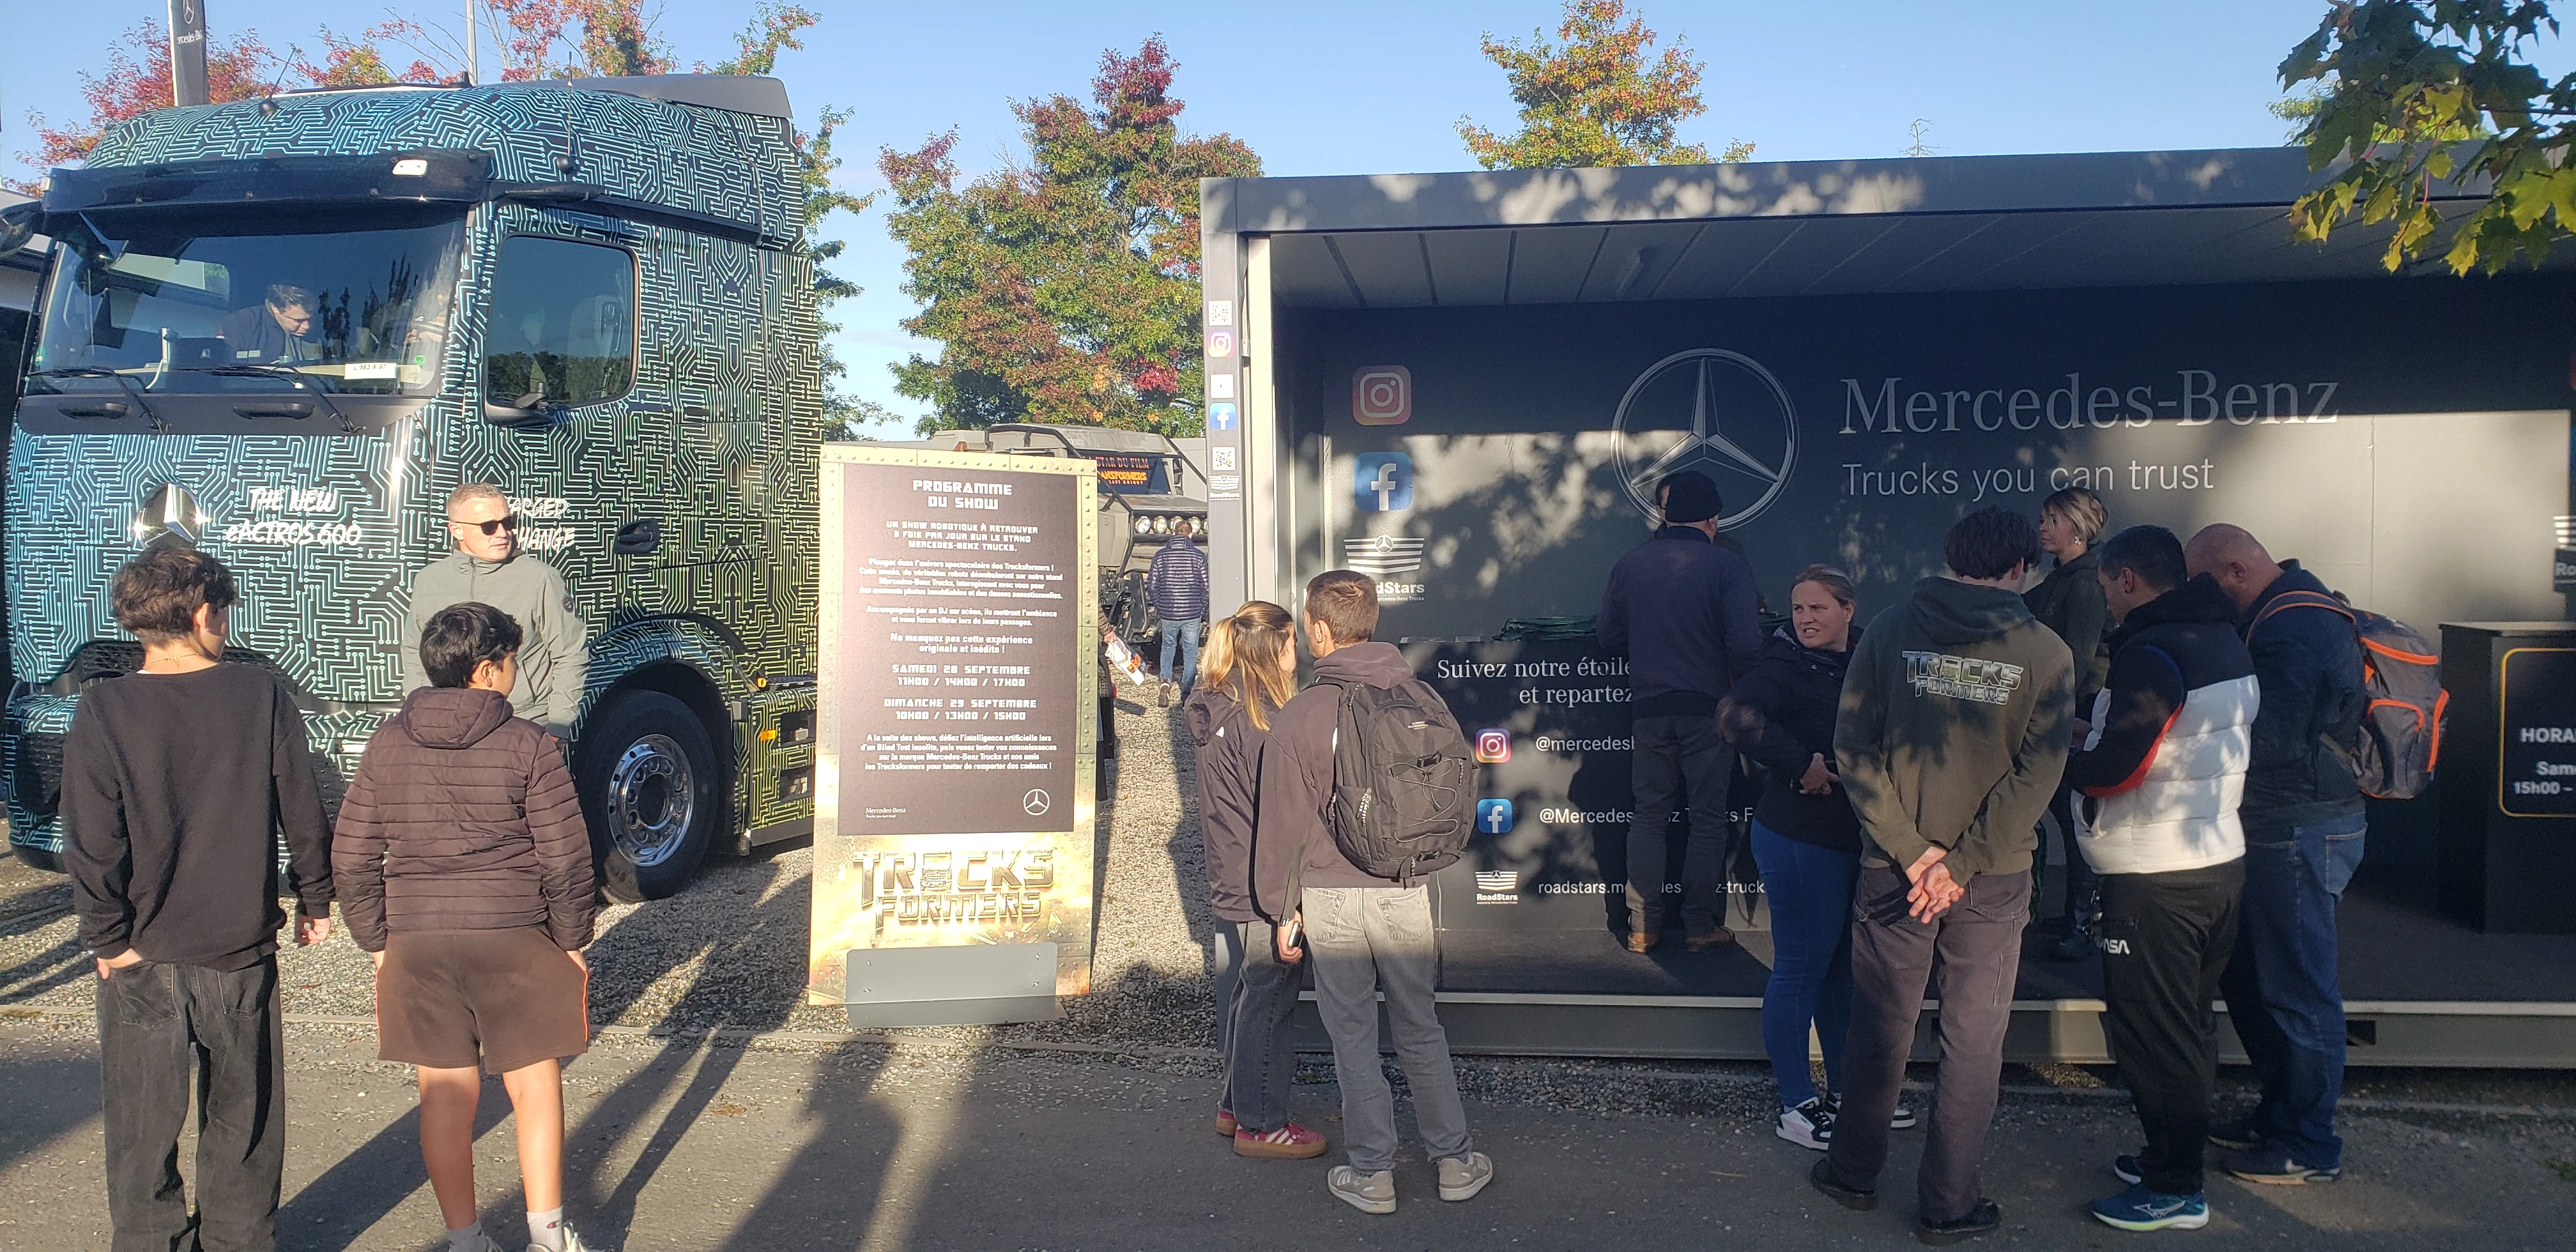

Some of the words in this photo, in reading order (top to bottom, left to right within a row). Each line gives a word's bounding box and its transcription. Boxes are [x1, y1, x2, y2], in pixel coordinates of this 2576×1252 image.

[1839, 369, 2340, 434] Mercedes-Benz
[1096, 456, 1116, 467] STAR
[1117, 457, 1129, 468] DU
[1130, 457, 1149, 468] FILM
[912, 480, 1012, 495] PROGRAMME
[1842, 462, 1959, 496] Trucks
[1972, 468, 2035, 502] you
[2050, 464, 2114, 490] can
[2128, 458, 2214, 490] trust
[250, 489, 285, 511] THE
[289, 489, 337, 512] NEW
[928, 495, 947, 507] DU
[954, 496, 998, 510] SHOW
[225, 519, 314, 547] eACTROS
[318, 523, 362, 546] 600
[901, 521, 927, 529] SHOW
[930, 522, 977, 532] ROBOTIQUE
[980, 523, 986, 531] À
[989, 524, 1038, 533] RETROUVER
[512, 527, 575, 553] HANGE
[924, 531, 942, 539] PAR
[908, 540, 979, 550] MERCEDES-BENZ
[981, 543, 1017, 551] TRUCKS.
[1376, 582, 1425, 594] dStars
[890, 632, 903, 641] Ne
[905, 634, 943, 644] manquez
[944, 636, 960, 644] pas
[985, 634, 1032, 646] expérience
[919, 643, 958, 654] originale
[970, 644, 999, 653] inédite
[892, 664, 937, 673] SAMEDI
[943, 665, 958, 673] 28
[964, 665, 1030, 675] SEPTEMBRE
[1438, 659, 1507, 678] Suivez
[1514, 659, 1570, 677] notre
[897, 676, 928, 685] 11H00
[944, 677, 977, 686] 14H00
[993, 678, 1025, 687] 17H00
[1519, 686, 1539, 703] et
[1545, 685, 1632, 708] repartez
[1915, 675, 2011, 706] FORMERS
[884, 698, 943, 707] DIMANCHE
[949, 699, 964, 707] 29
[970, 699, 1036, 708] SEPTEMBRE
[895, 711, 928, 719] 10H00
[944, 711, 978, 719] 13H00
[993, 712, 1025, 720] 15H00
[2536, 760, 2576, 775] Sam
[2513, 781, 2561, 795] 15h00
[875, 891, 1041, 933] FORMERS
[2100, 938, 2131, 954] ASA
